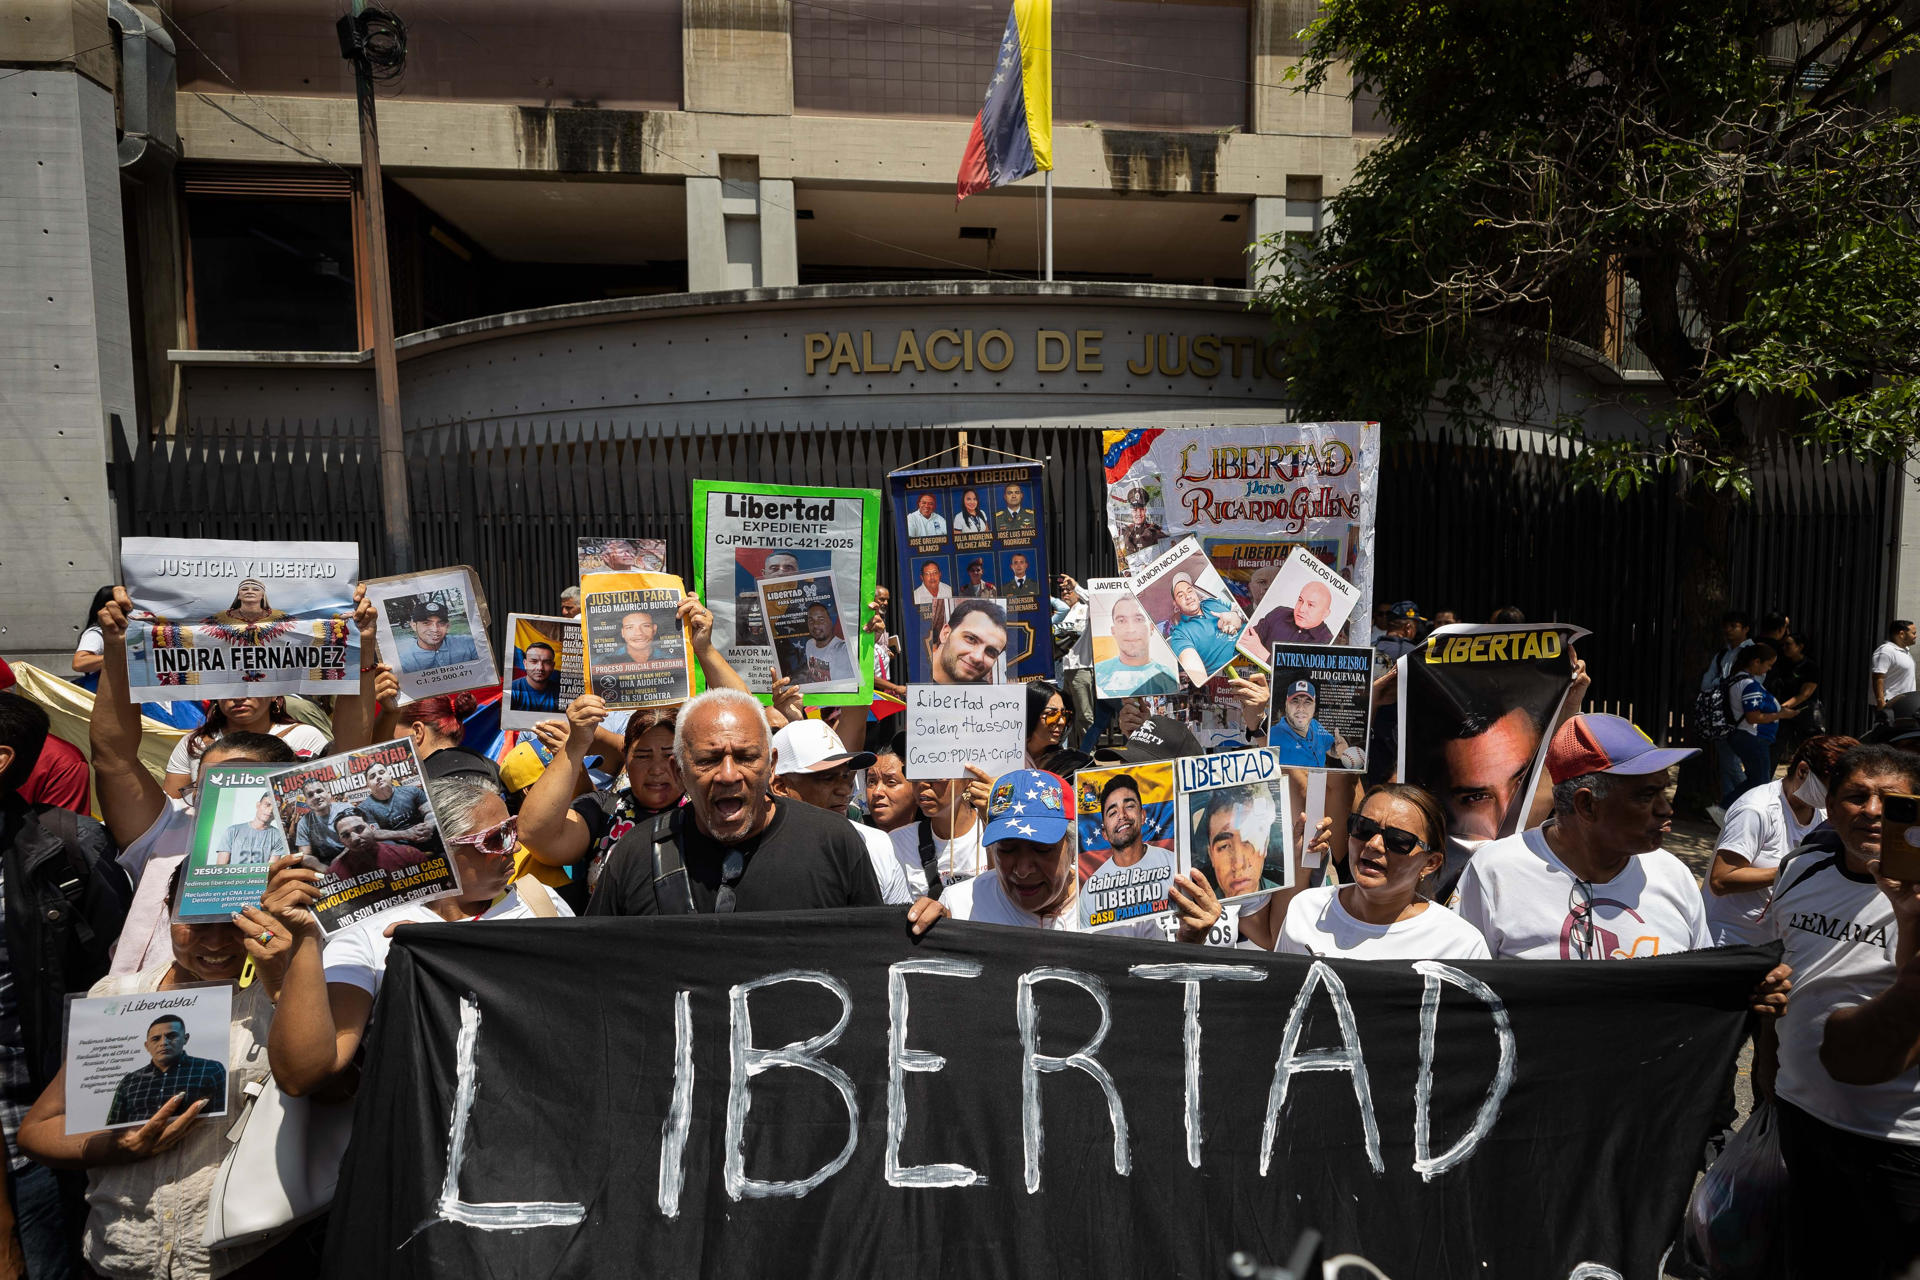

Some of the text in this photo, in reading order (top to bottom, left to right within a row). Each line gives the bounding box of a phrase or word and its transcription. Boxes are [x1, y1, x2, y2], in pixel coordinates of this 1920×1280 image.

[804, 329, 1014, 374] PALACIO
[1037, 330, 1103, 373] DE
[1176, 440, 1354, 488] LIBERTAD
[906, 468, 1029, 489] JUSTICIA Y LIBERTAD
[725, 494, 835, 522] Libertad
[743, 521, 828, 534] EXPEDIENTE
[715, 534, 854, 549] CJPM-TM1C-421-2025
[922, 536, 948, 545] GREGORIO
[155, 559, 337, 579] JUSTICIA Y LIBERTAD
[1136, 544, 1190, 588] JUNIOR NICOLÁS
[1238, 560, 1270, 568] Ricardo
[1299, 553, 1349, 596] CARLOS VIDAL
[767, 589, 802, 601] LIBERTAD
[1094, 582, 1122, 590] JAVIER
[590, 590, 672, 606] JUSTICIA PARA
[590, 600, 678, 614] DIEGO MAURICIO BURGOS
[155, 641, 345, 672] INDIRA FERNÁNDEZ
[728, 649, 759, 657] MAYOR
[1425, 632, 1562, 664] LIBERTAD
[421, 664, 464, 677] Joel Bravo
[595, 660, 683, 673] PROCESO JUDICIAL RETARDADO
[1276, 652, 1326, 669] ENTRENADOR
[1327, 655, 1337, 669] DE
[1338, 656, 1368, 670] BEISBOL
[416, 670, 472, 686] C.I. 25.000.471
[620, 677, 674, 688] UNA AUDIENCIA
[1310, 670, 1366, 682] JULIO GUEVARA
[567, 684, 586, 694] AÑOS
[632, 694, 641, 702] SU
[644, 692, 671, 701] CONTRA
[917, 690, 1020, 718] Libertad para
[915, 715, 1023, 741] Salem Hassoun
[277, 746, 408, 796] ¡JUSTICIA Y LIBERTAD
[330, 760, 412, 795] INMEDATA!
[1182, 750, 1274, 791] LIBERTAD
[194, 866, 223, 876] JESÚS
[312, 872, 340, 888] UNCA
[390, 867, 449, 891] DEVASTADOR
[391, 857, 446, 881] EN UN CASO
[1087, 865, 1171, 893] Gabriel Barros
[321, 868, 387, 897] BIERON ESTAR
[315, 879, 385, 913] INVOLUCRADOS
[337, 883, 442, 928] ¡NO SON PDVSA-CRIPTO!
[1094, 882, 1162, 912] LIBERTAD
[1090, 899, 1169, 926] CASO PARAMACAY
[437, 957, 1519, 1231] LIBERTAD
